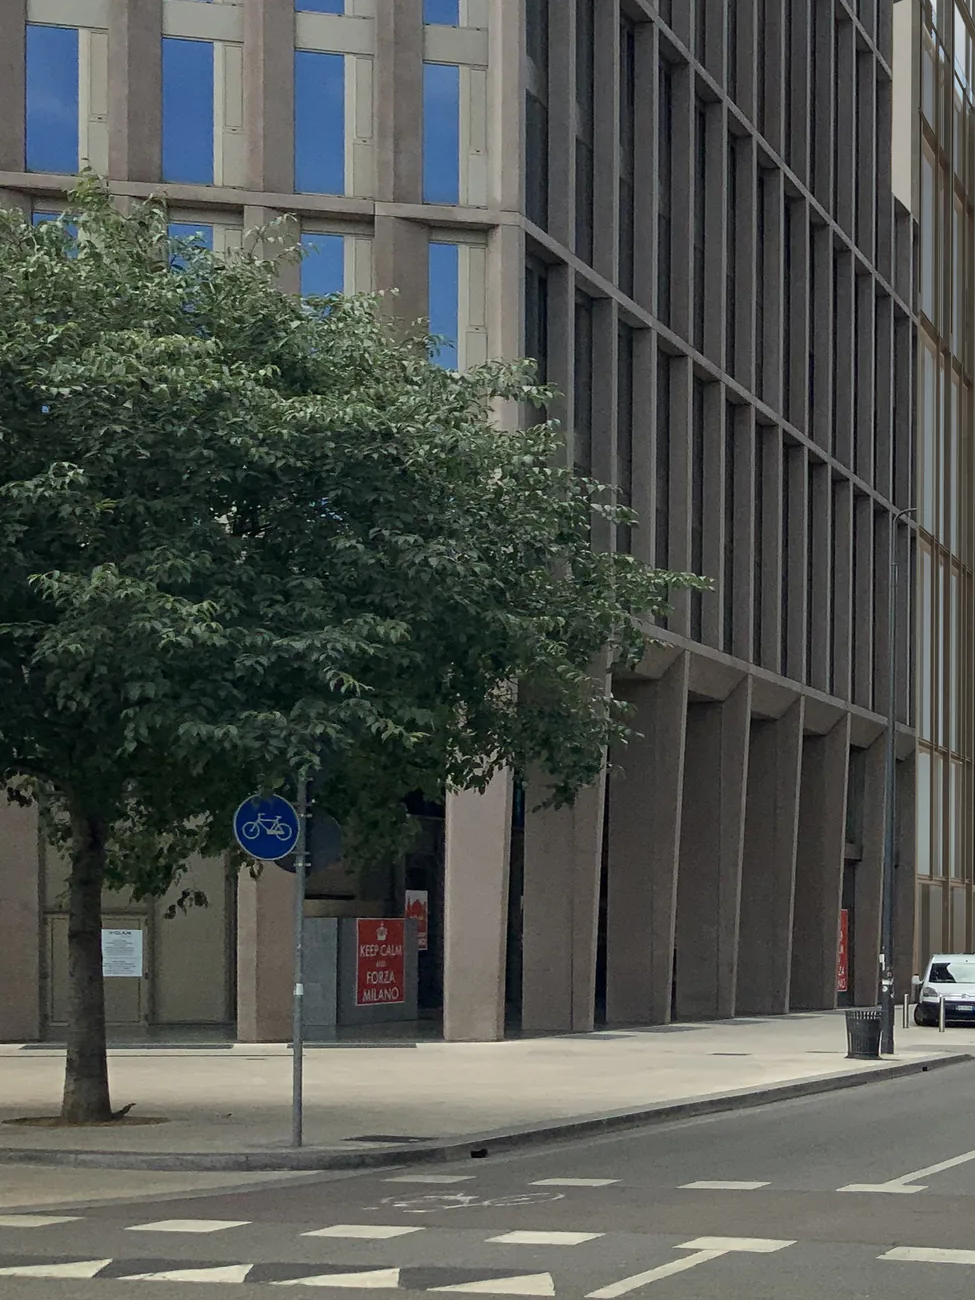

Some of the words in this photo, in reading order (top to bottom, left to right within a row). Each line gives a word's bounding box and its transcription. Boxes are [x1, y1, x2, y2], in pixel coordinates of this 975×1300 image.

[360, 945, 379, 957] KEEP
[380, 945, 402, 956] CALM
[366, 971, 396, 984] FORZA
[362, 987, 399, 1002] MILANO
